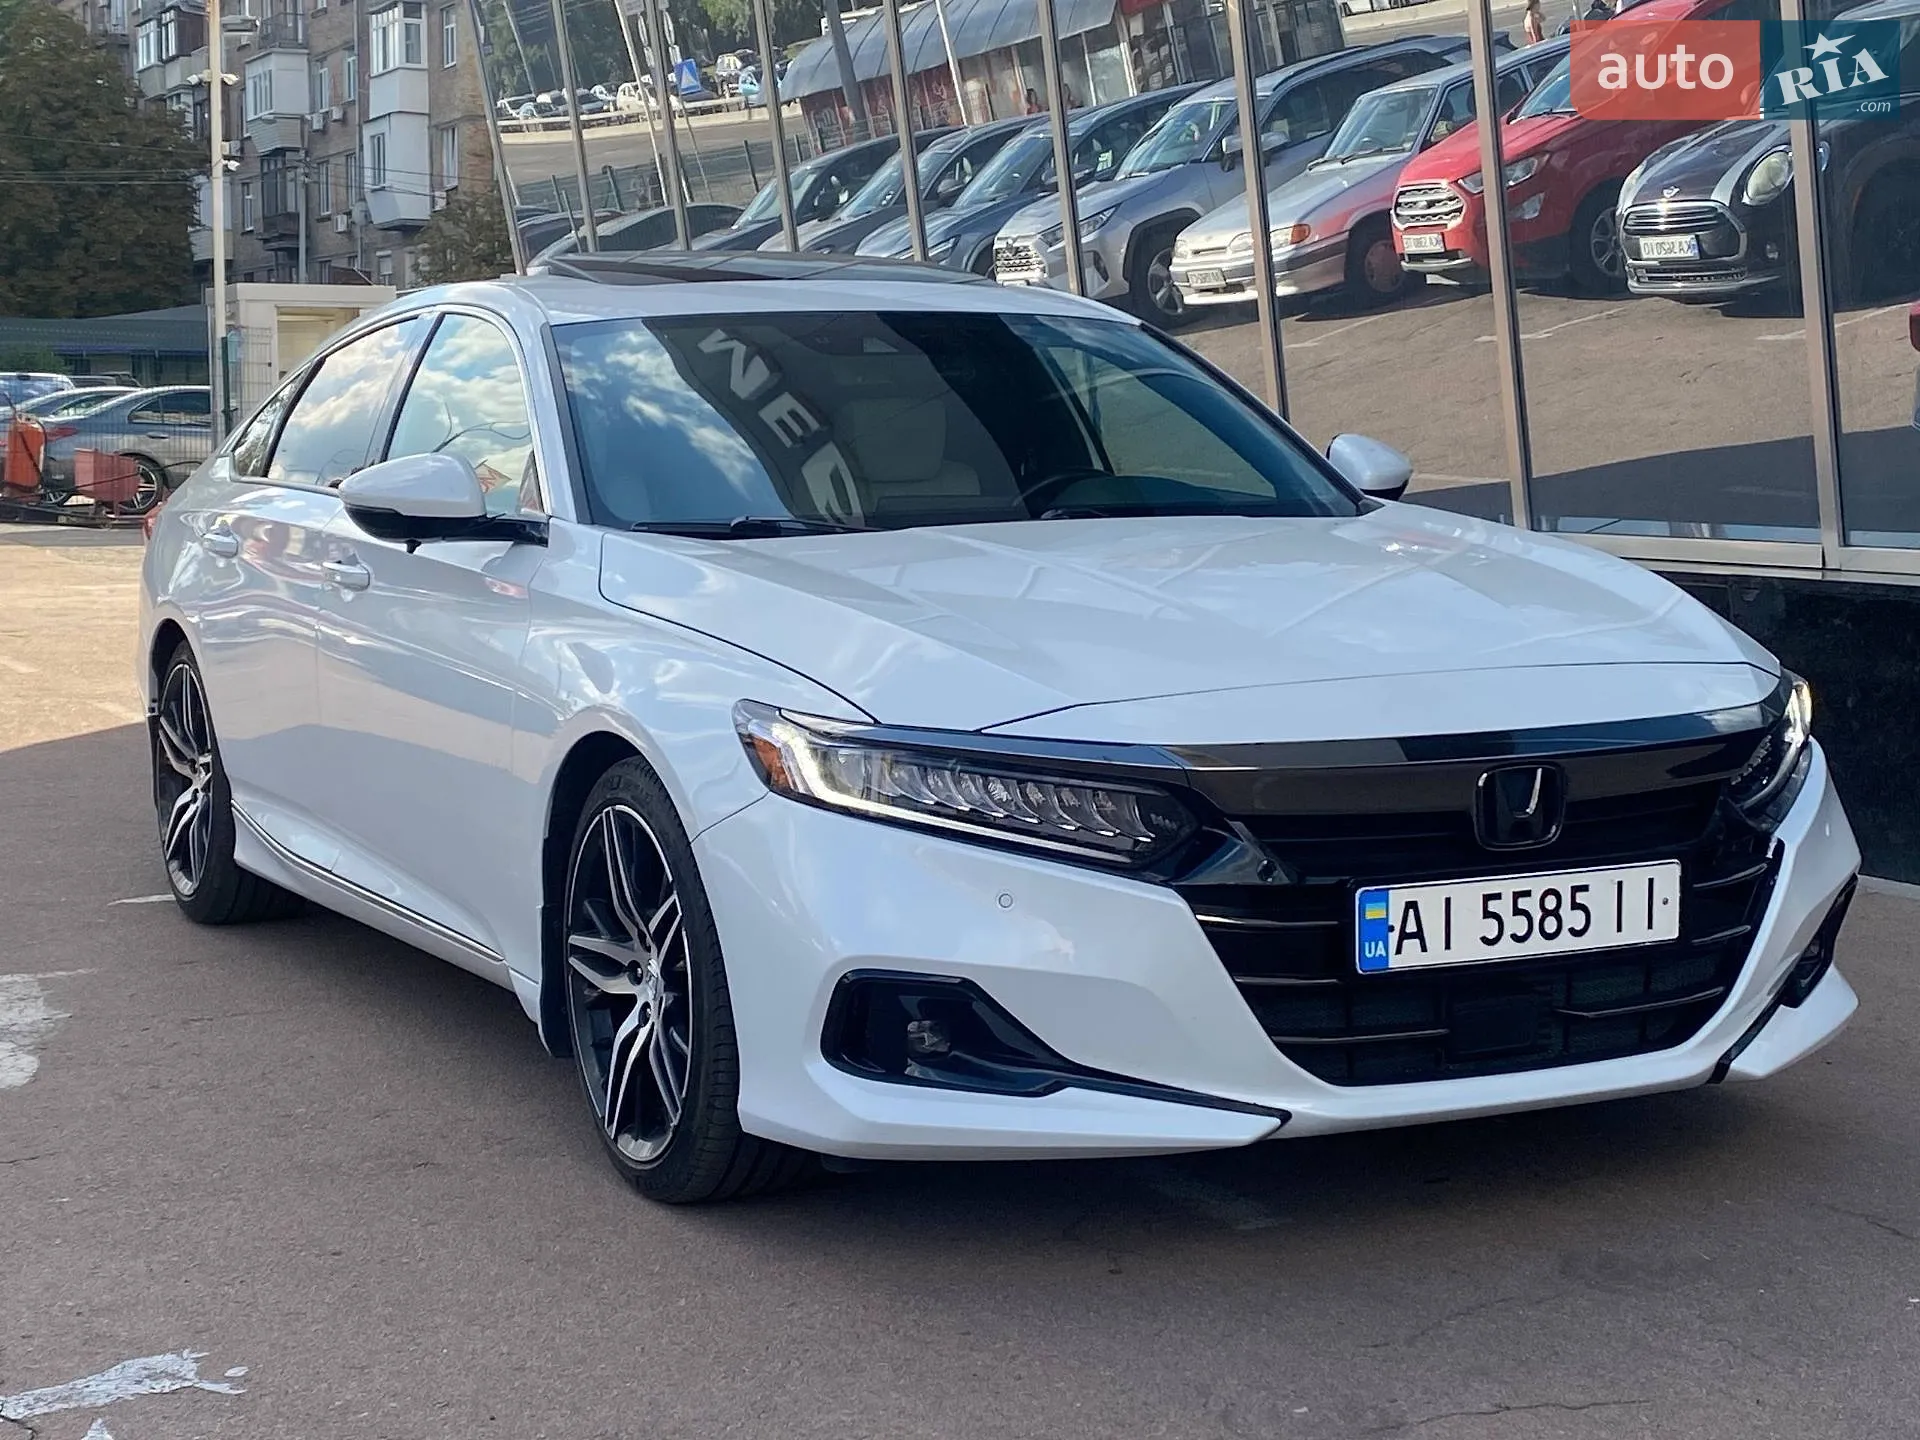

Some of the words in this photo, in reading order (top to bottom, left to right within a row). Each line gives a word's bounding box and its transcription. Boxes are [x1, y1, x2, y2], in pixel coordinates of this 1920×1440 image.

[1395, 897, 1452, 955] AI
[1480, 884, 1591, 946] 5585
[1616, 877, 1655, 933] II
[1365, 941, 1387, 958] UA
